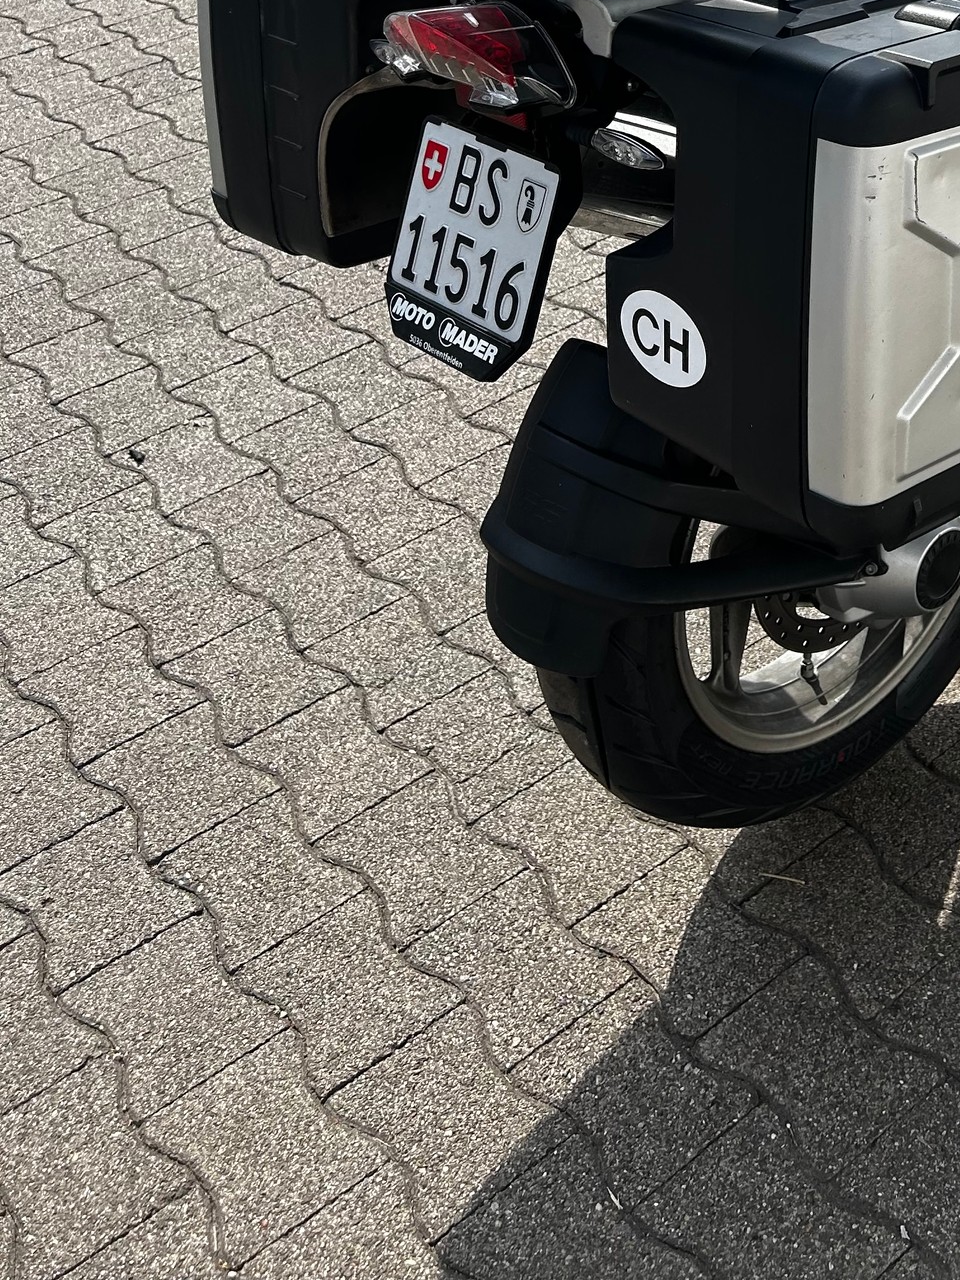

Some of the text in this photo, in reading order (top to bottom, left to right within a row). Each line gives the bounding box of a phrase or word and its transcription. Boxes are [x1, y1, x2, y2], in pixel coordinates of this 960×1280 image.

[450, 144, 508, 226] BS
[401, 214, 525, 331] 11516
[390, 293, 498, 364] MOTO MADER
[409, 334, 463, 369] 5036 Oberentfelden
[632, 307, 690, 374] CH
